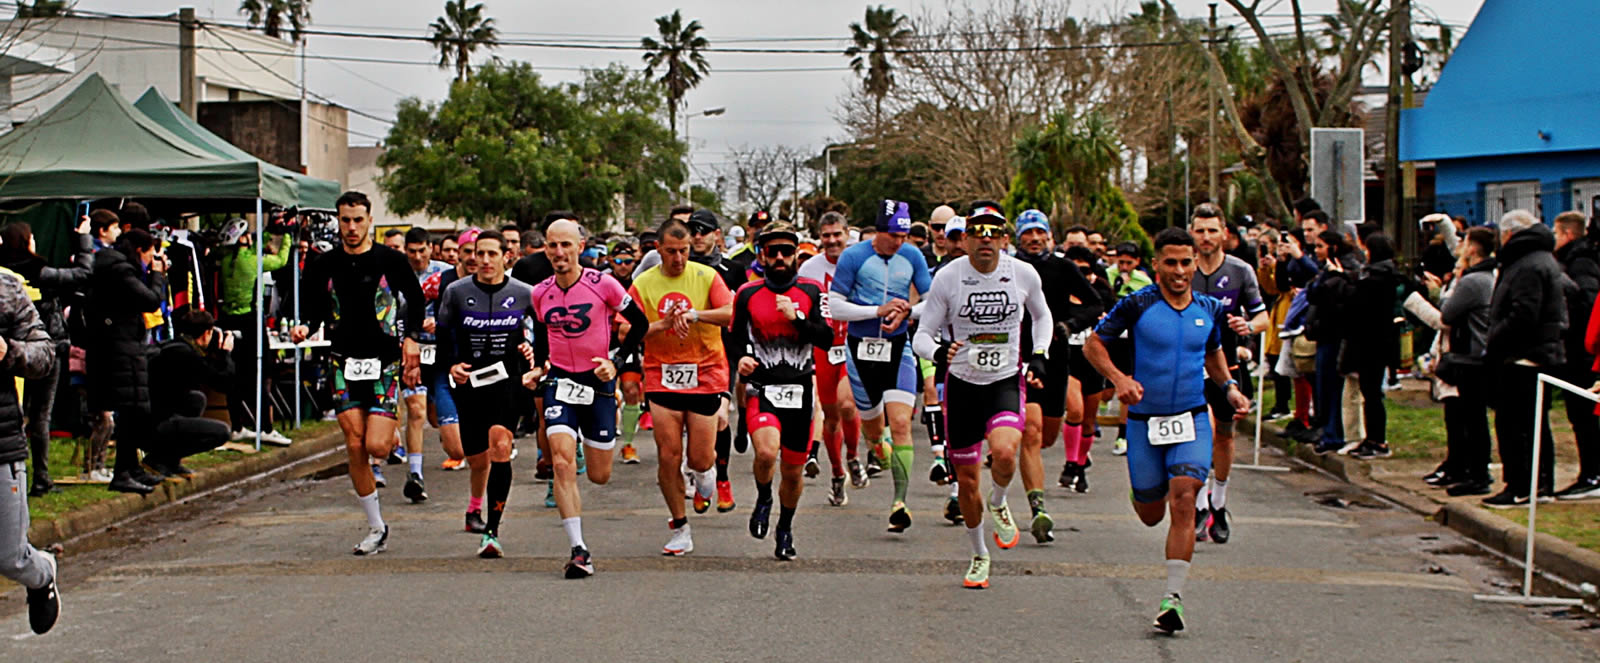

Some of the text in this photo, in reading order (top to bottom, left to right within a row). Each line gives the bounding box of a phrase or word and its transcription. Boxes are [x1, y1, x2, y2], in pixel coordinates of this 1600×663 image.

[866, 342, 885, 356] 67
[977, 351, 1000, 367] 88
[353, 361, 372, 375] 32
[665, 370, 694, 384] 327
[567, 383, 585, 398] 72
[1158, 420, 1183, 437] 50
